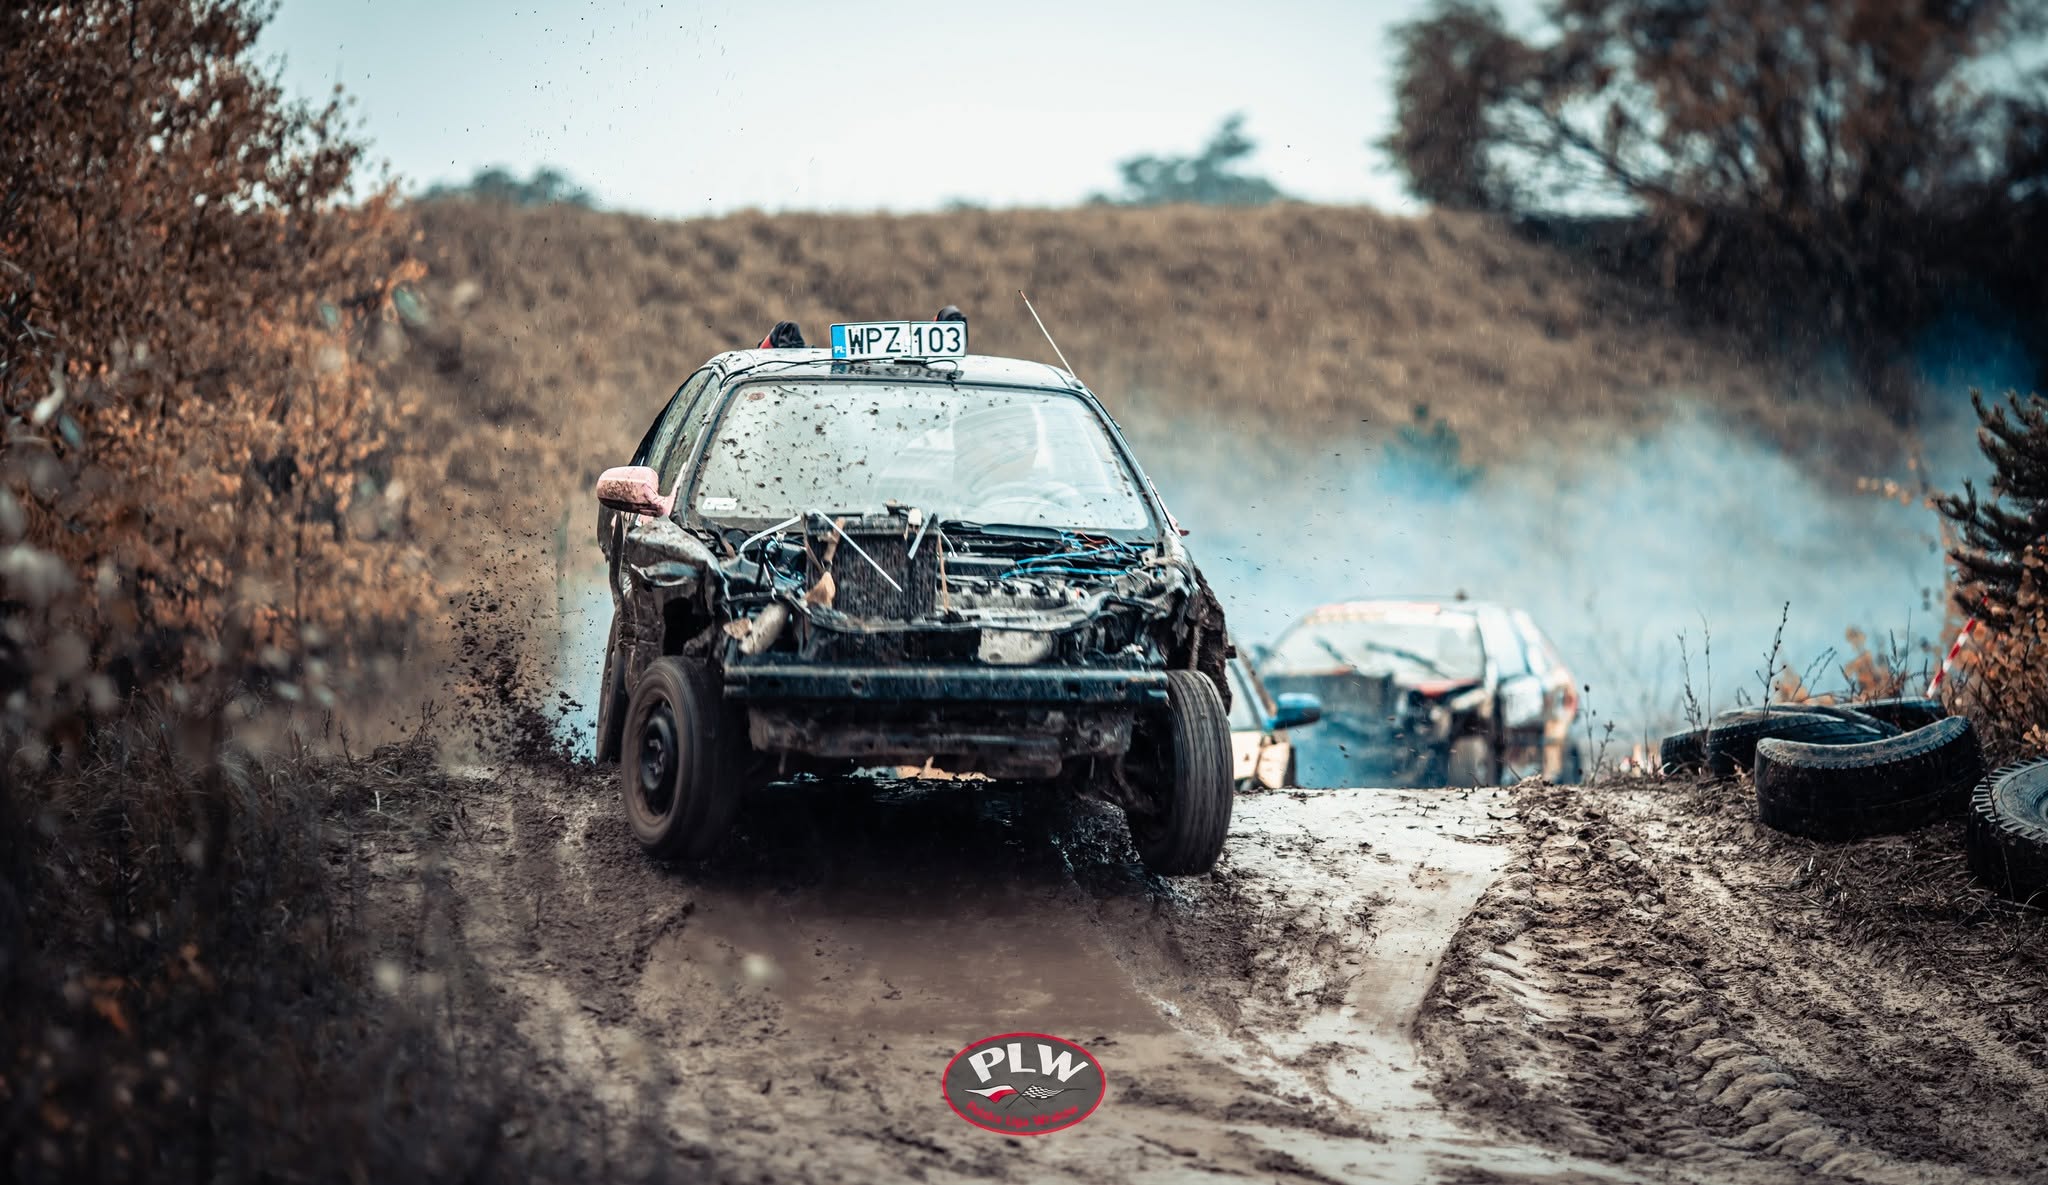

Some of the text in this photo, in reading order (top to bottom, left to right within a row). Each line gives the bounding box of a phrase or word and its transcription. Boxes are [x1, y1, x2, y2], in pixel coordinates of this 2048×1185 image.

[834, 345, 845, 354] PL
[848, 327, 960, 354] WPZ 103
